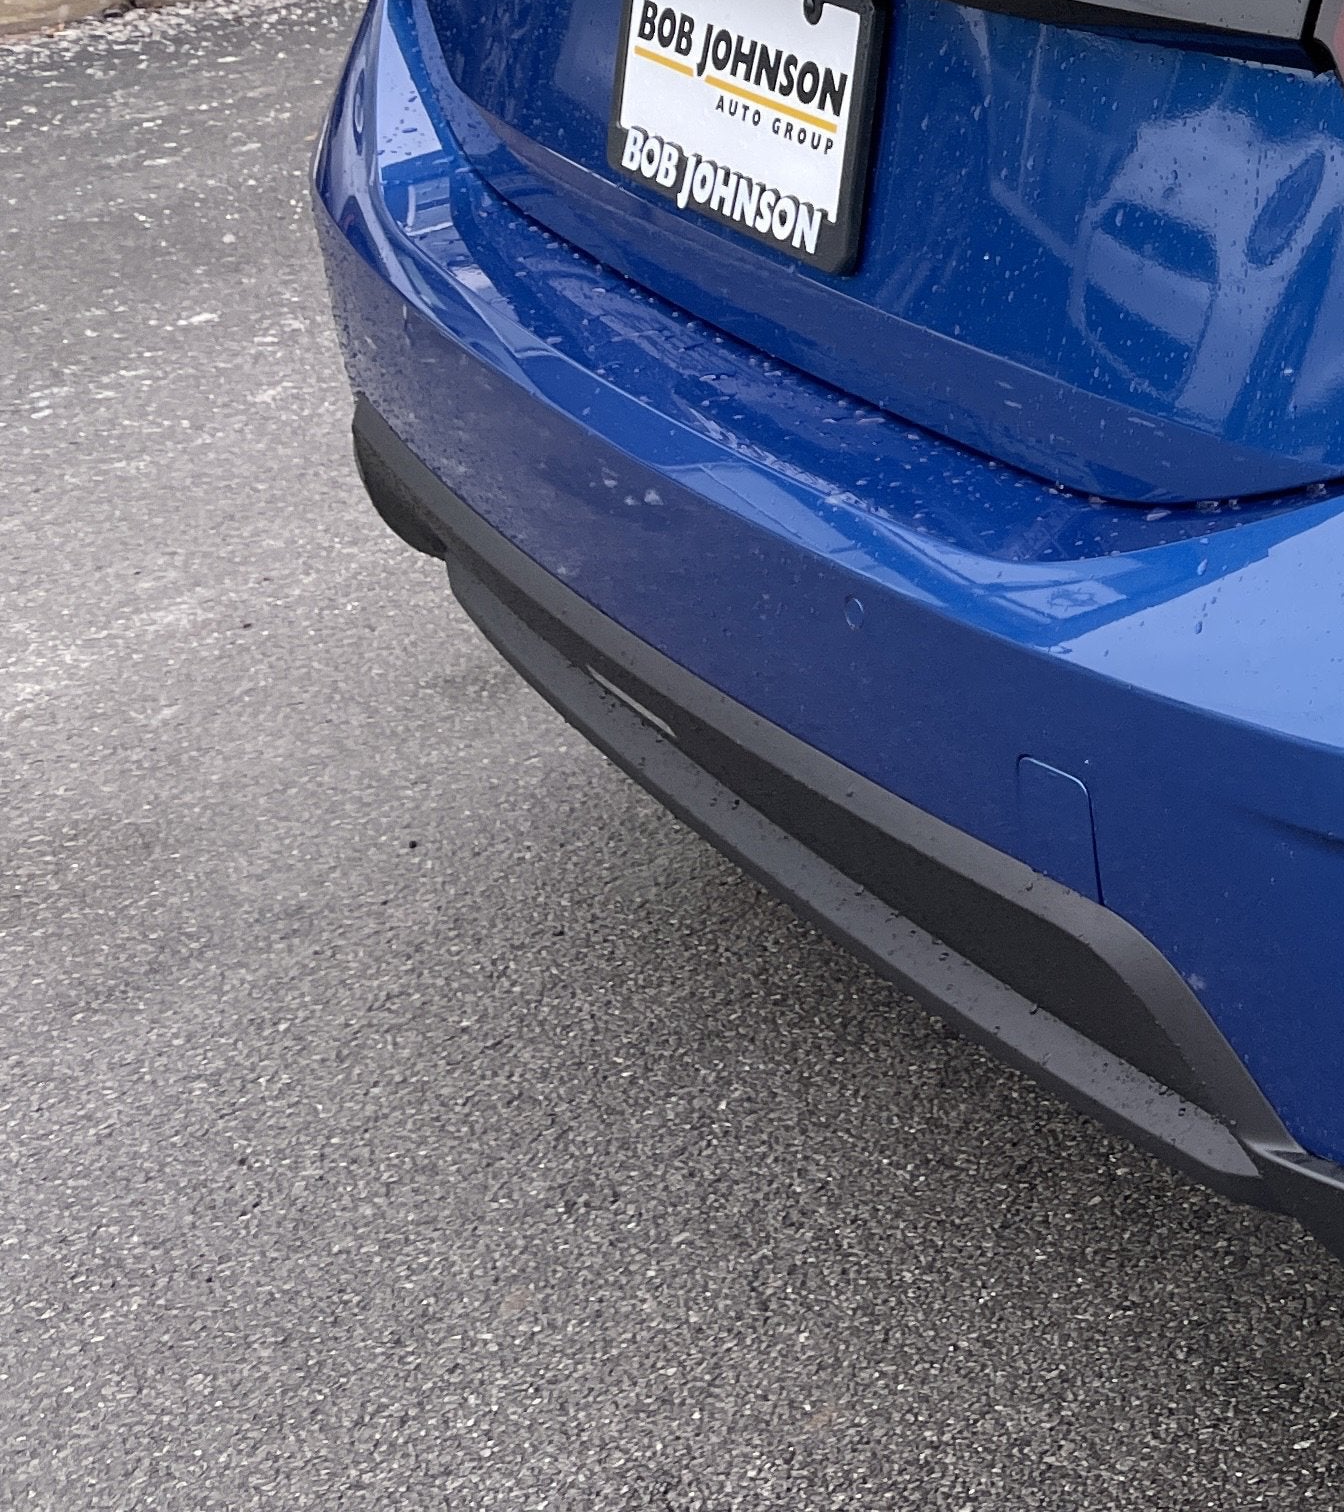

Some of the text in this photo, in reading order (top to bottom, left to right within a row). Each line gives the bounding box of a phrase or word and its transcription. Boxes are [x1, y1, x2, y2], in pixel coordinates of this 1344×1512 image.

[637, 0, 848, 117] BOB JOHNSON
[715, 95, 835, 155] AUTO GROUP
[622, 126, 824, 255] BOB JOHNSON
